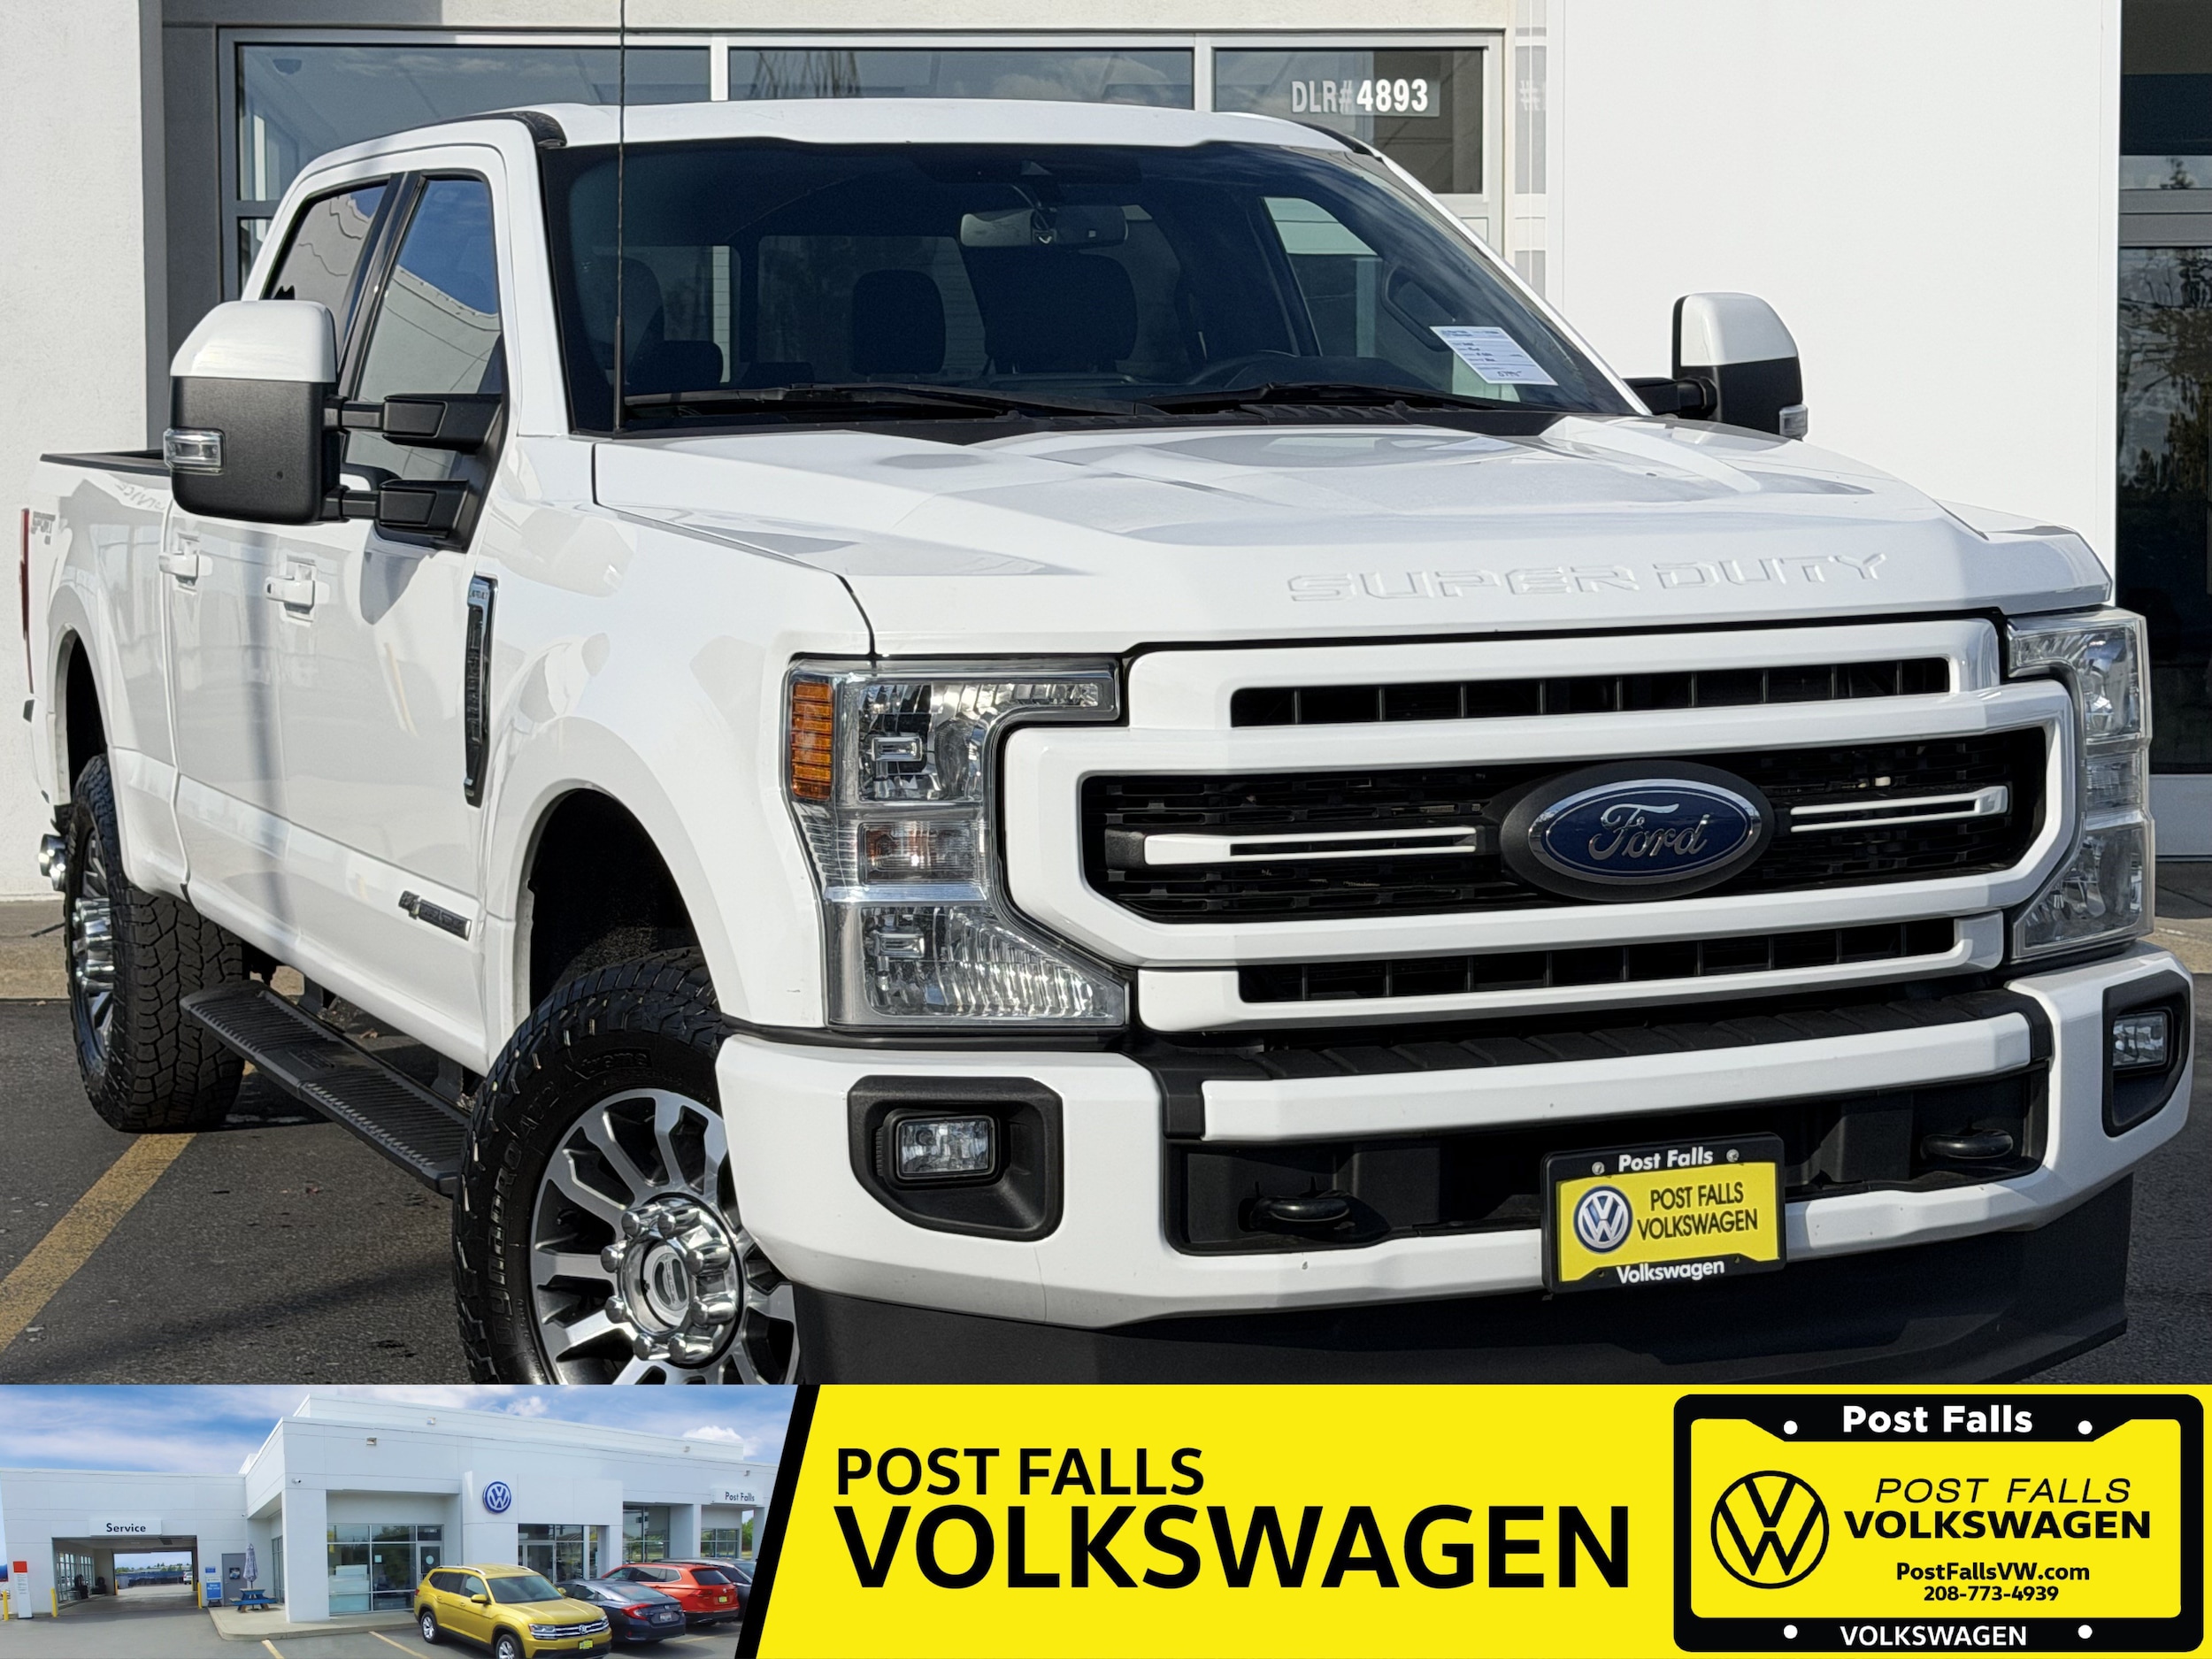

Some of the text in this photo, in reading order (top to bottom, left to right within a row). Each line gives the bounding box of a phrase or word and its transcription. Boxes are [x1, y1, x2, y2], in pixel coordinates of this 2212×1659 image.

[1287, 553, 1886, 603] SUPER DUTY
[1589, 803, 1709, 861] Ford
[1618, 1146, 1715, 1173] Post Falls
[1650, 1181, 1745, 1211] POST FALLS
[1637, 1208, 1758, 1240] VOLKSWAGEN
[1616, 1259, 1725, 1285] Volkswagen
[726, 1491, 755, 1502] Post Falls
[106, 1523, 146, 1532] Service
